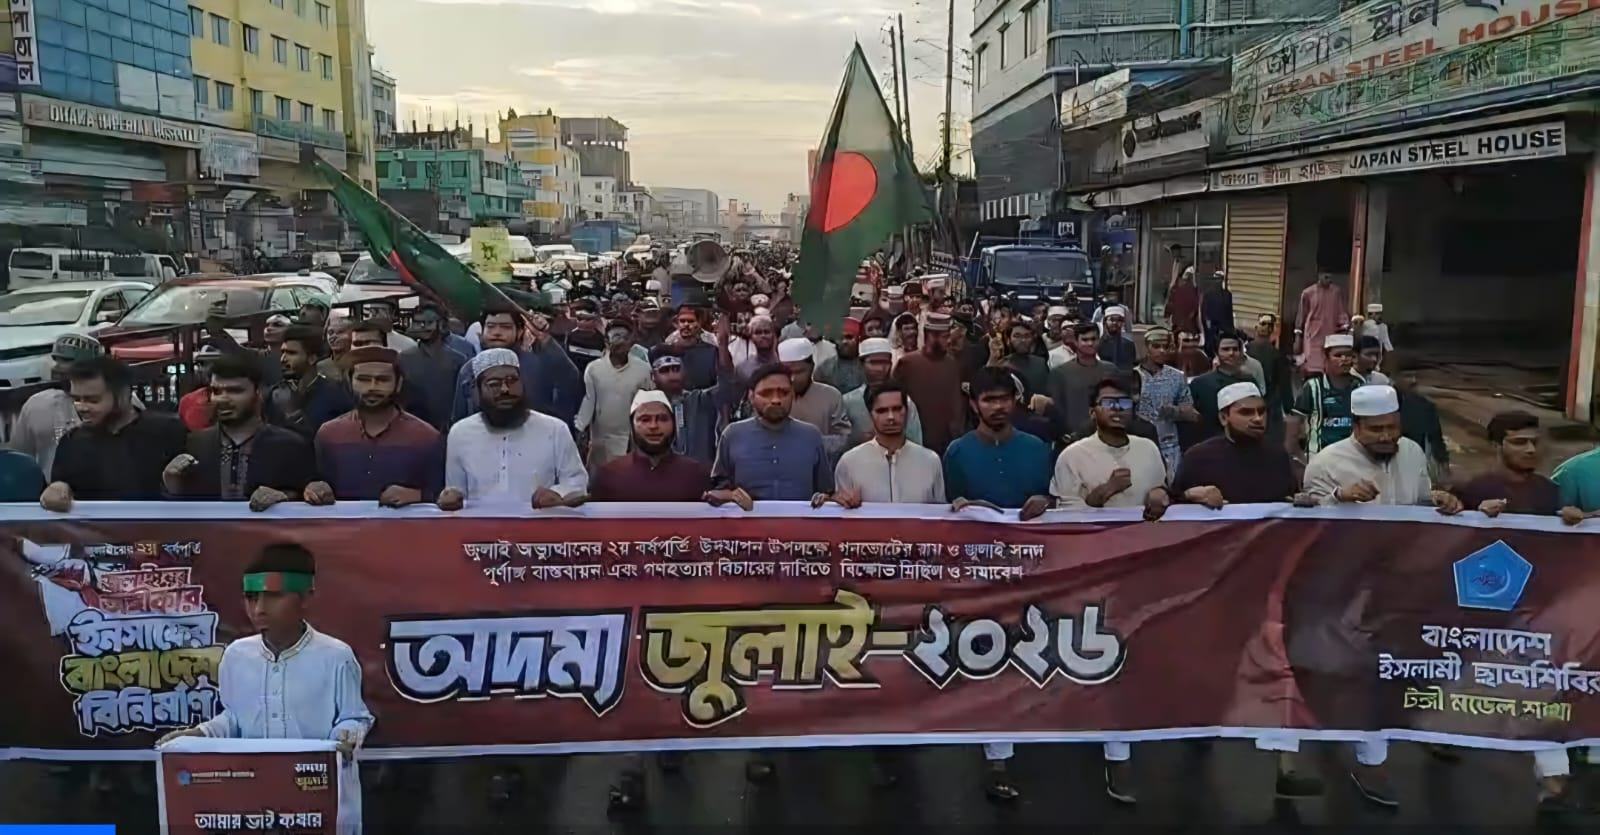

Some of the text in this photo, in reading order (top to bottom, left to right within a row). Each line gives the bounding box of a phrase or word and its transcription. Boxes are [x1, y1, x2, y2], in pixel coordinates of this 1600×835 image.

[1345, 38, 1445, 75] STEEL
[1350, 128, 1562, 170] JAPAN STEEL HOUSE
[462, 538, 512, 561] জুলাই
[607, 541, 630, 558] ২য়
[633, 536, 691, 557] বর্ষপূর্তি
[947, 544, 960, 557] ও
[608, 563, 637, 579] এবং
[780, 559, 832, 577] দাবিতে
[947, 566, 961, 580] ও
[1421, 625, 1552, 656] বাংলাদেশ
[64, 646, 222, 690] বাংলাদেশ
[389, 612, 624, 708] অদম্য
[1378, 652, 1463, 681] ইসলামী
[1450, 693, 1516, 717] মডেল
[194, 813, 241, 830] আমার
[245, 809, 275, 830] ভাই
